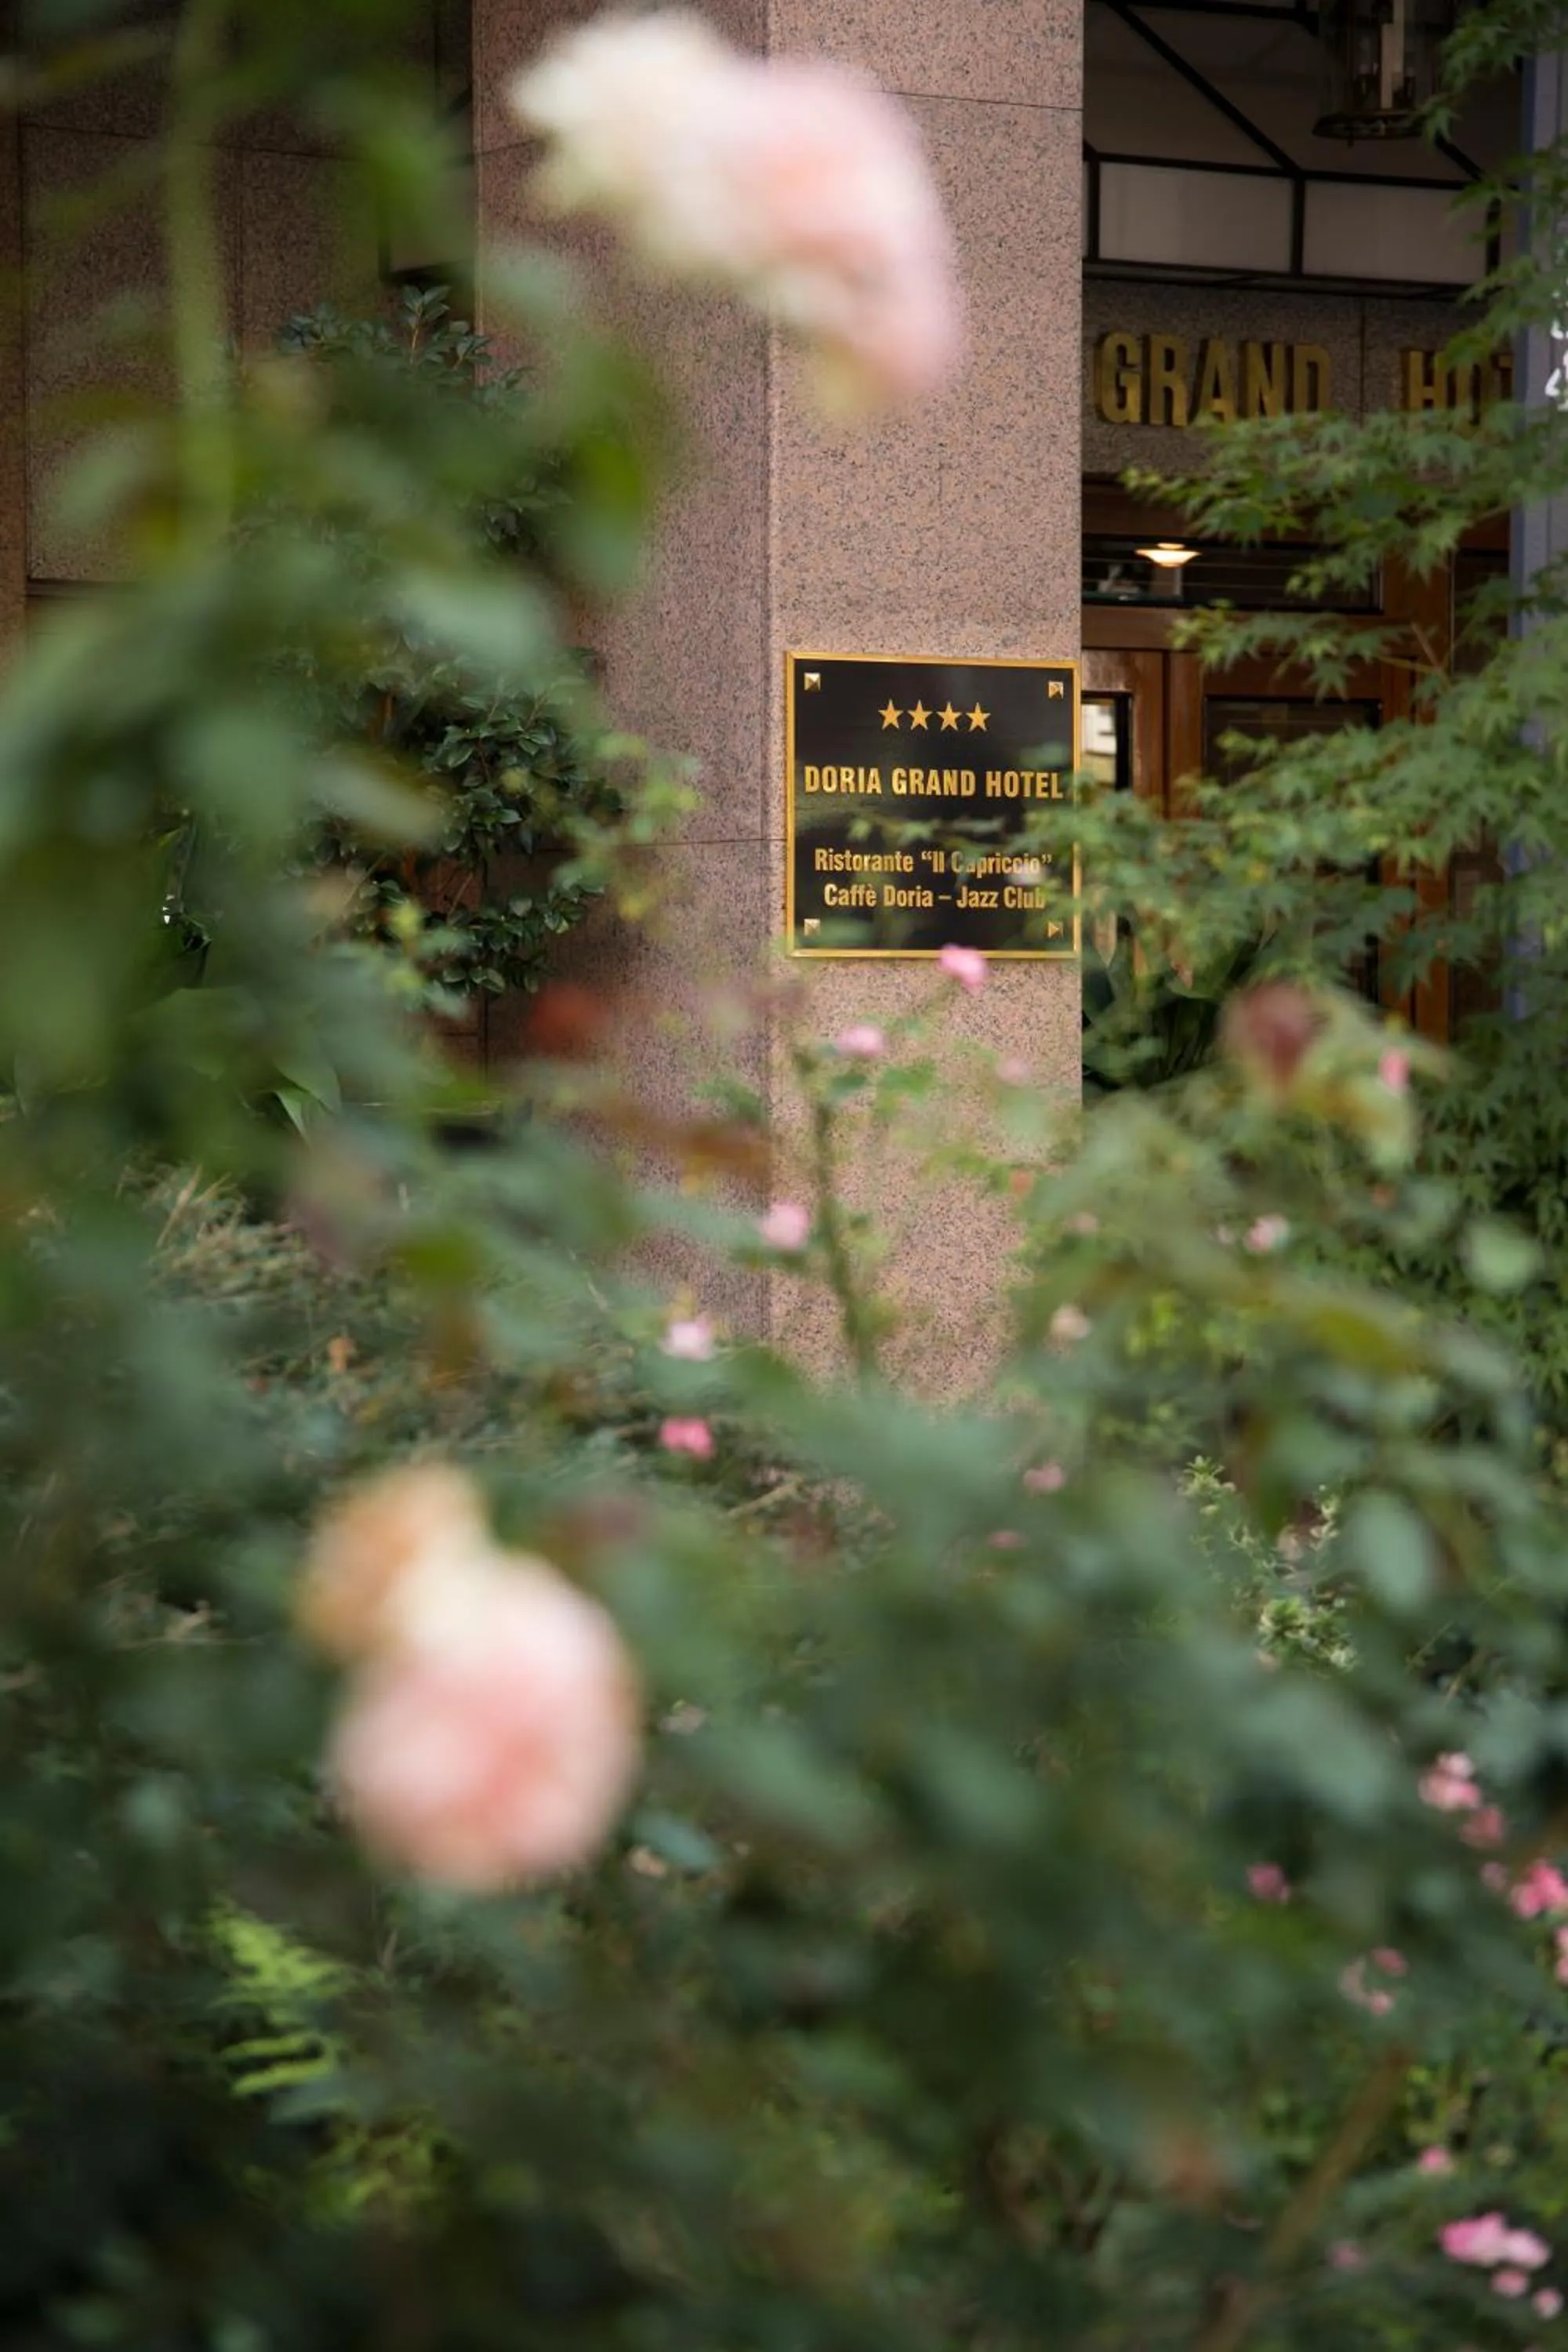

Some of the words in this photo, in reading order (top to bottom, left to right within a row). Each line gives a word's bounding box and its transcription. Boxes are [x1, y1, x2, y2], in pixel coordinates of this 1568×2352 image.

[1099, 331, 1331, 426] GRAND
[804, 765, 882, 795] DORIA
[892, 768, 976, 797] GRAND
[985, 771, 1064, 800] HOTEL
[815, 848, 914, 873] Ristorante
[824, 883, 877, 907] Caffè
[884, 884, 934, 908] Doria
[956, 885, 1000, 909] Jazz
[1004, 886, 1046, 910] Club
